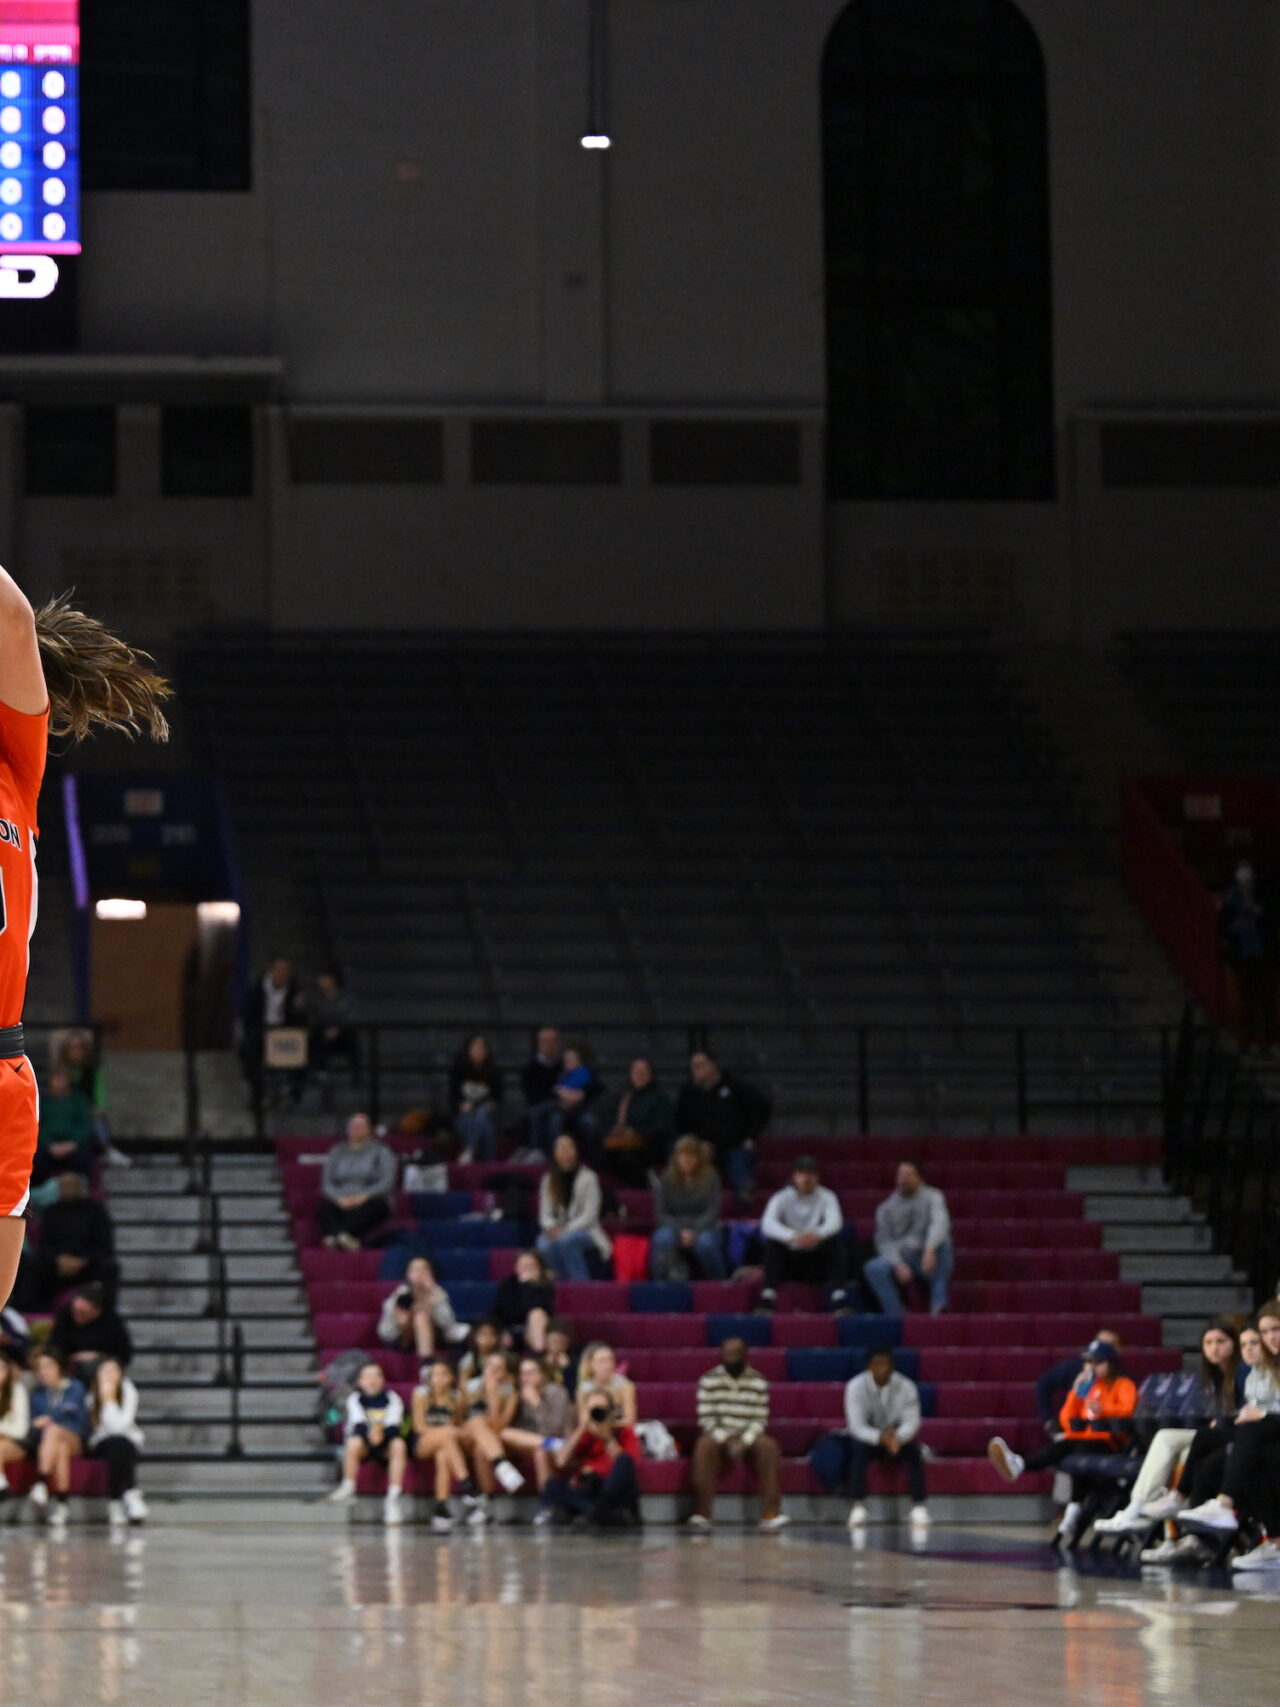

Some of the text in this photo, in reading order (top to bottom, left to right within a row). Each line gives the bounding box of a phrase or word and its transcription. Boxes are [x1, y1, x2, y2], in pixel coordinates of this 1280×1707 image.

[0, 70, 21, 99] 0
[42, 70, 65, 99] 0
[0, 106, 22, 134] 0
[42, 106, 66, 134] 0
[0, 141, 22, 170] 0
[42, 141, 66, 170] 0
[0, 177, 22, 206] 0
[43, 177, 66, 206] 0
[0, 212, 22, 241] 0
[43, 212, 66, 241] 0
